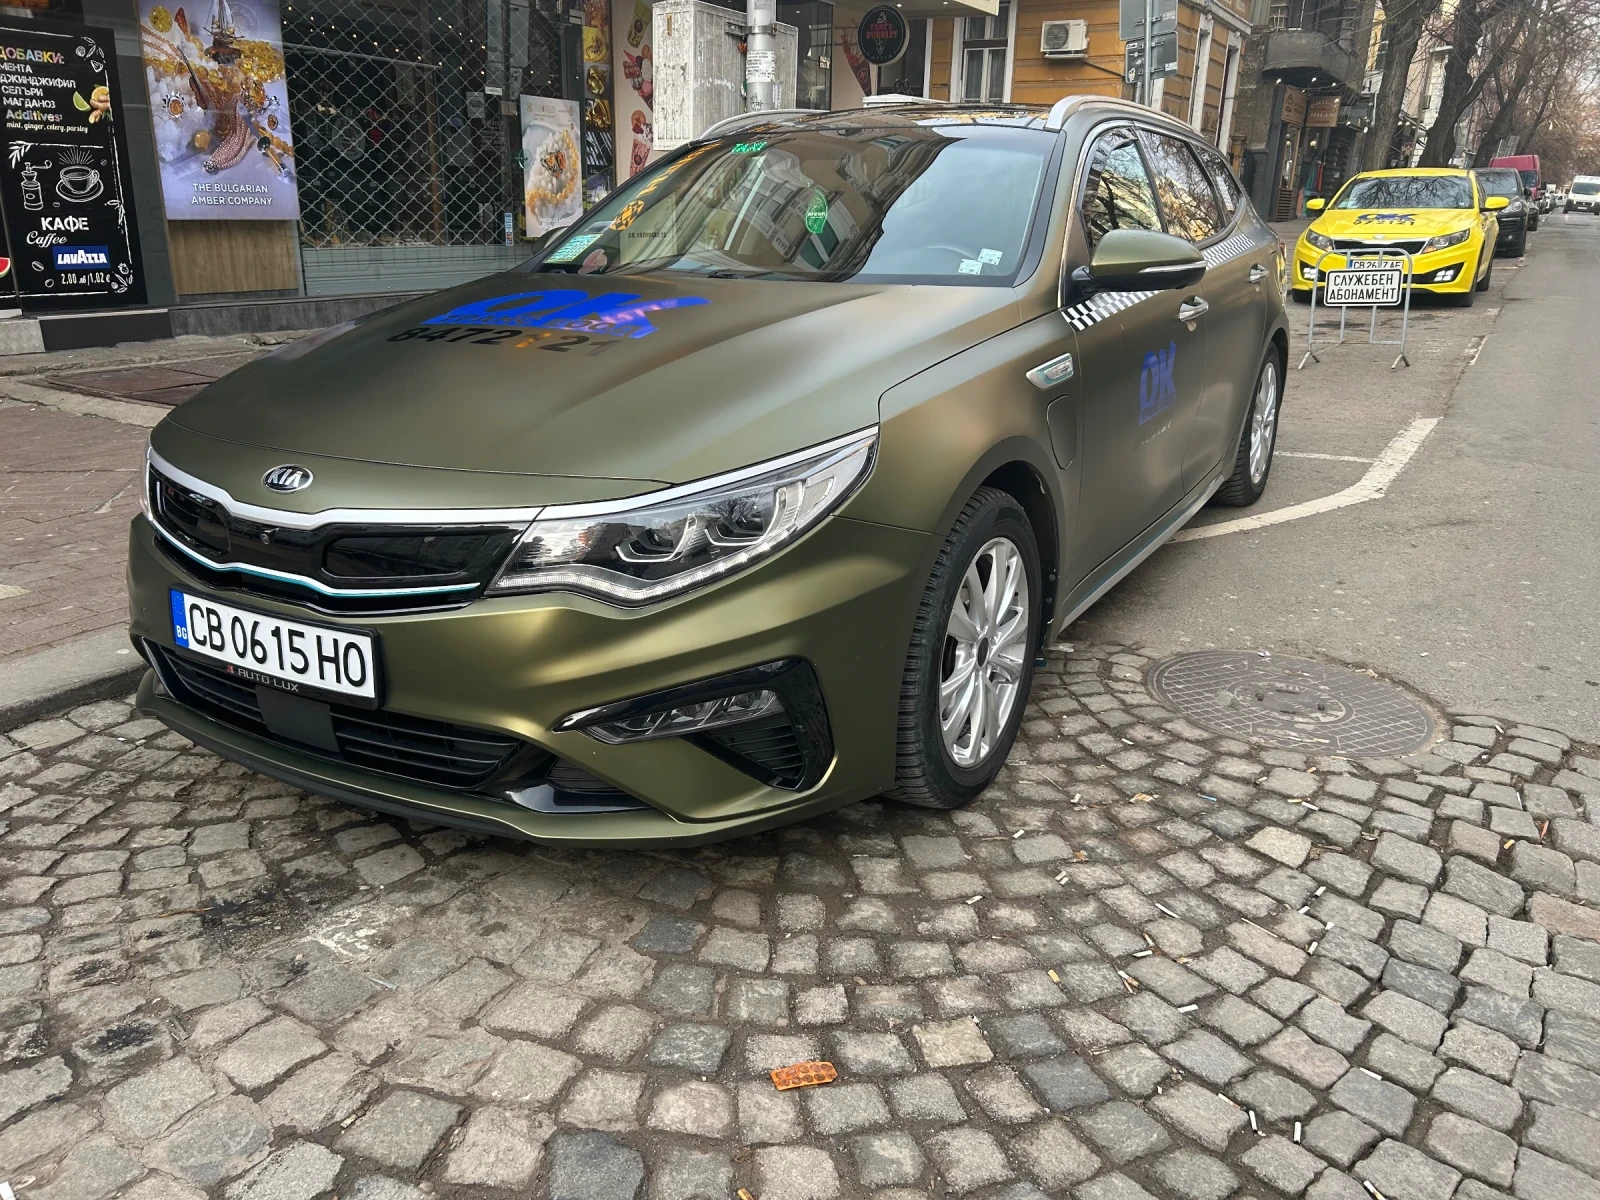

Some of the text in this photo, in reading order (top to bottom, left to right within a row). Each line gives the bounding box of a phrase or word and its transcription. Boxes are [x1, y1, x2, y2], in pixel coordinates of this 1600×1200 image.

[0, 62, 33, 73] МЕНТА
[0, 73, 76, 88] ДЖИНДЖИФИЛ
[1, 85, 43, 97] СЕЛЪРИ
[3, 96, 56, 108] МАГДАНОЗ
[193, 183, 268, 193] THE BULGARIAN
[191, 196, 272, 206] AMBER COMPANY
[41, 215, 90, 232] КАФЕ
[26, 230, 68, 248] Caffee
[57, 250, 108, 265] LAVAZZA
[60, 273, 77, 285] 2.00
[1333, 274, 1394, 286] СЛУЖЕБЕН
[1329, 287, 1396, 300] АБОНАМЕНТ
[267, 468, 304, 487] KIA
[176, 624, 188, 640] BG
[231, 615, 309, 675] 0615
[238, 668, 299, 693] AUTO LUX
